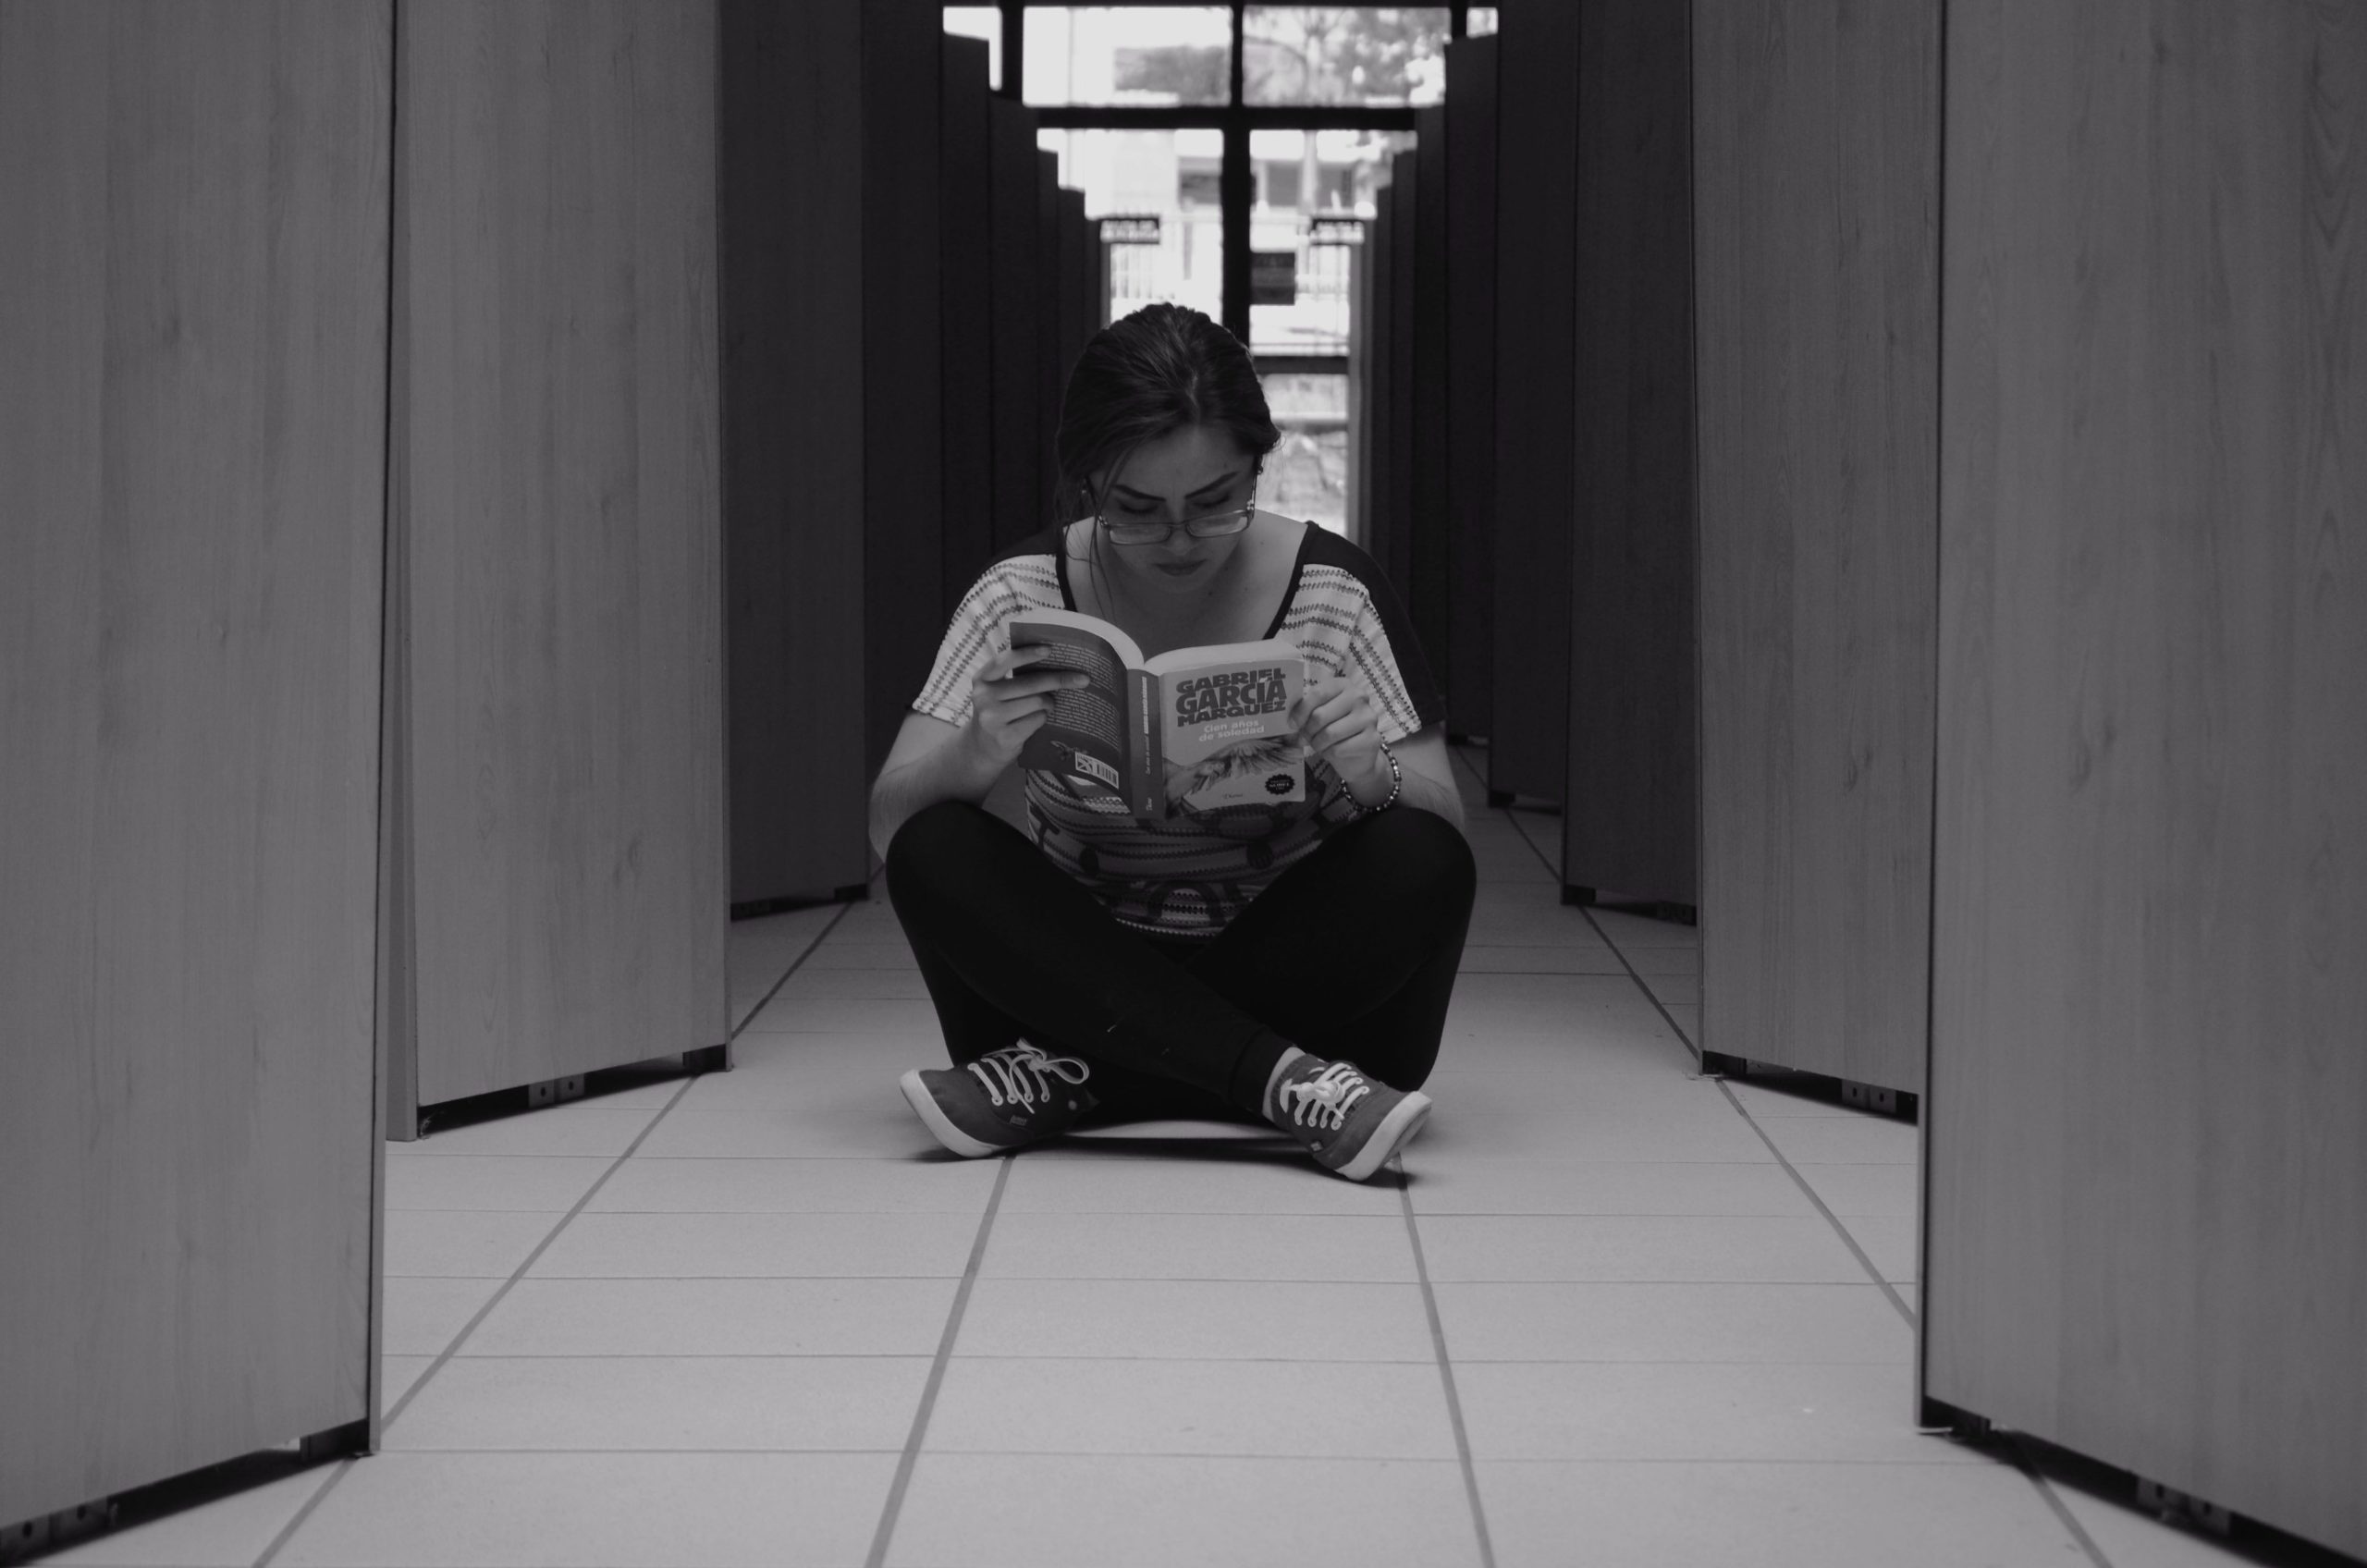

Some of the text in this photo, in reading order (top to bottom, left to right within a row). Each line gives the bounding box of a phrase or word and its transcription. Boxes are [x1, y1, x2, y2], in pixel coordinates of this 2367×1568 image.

[1176, 668, 1286, 694] GABRIEL
[1198, 725, 1264, 742] de soledad
[1204, 724, 1228, 733] Cien
